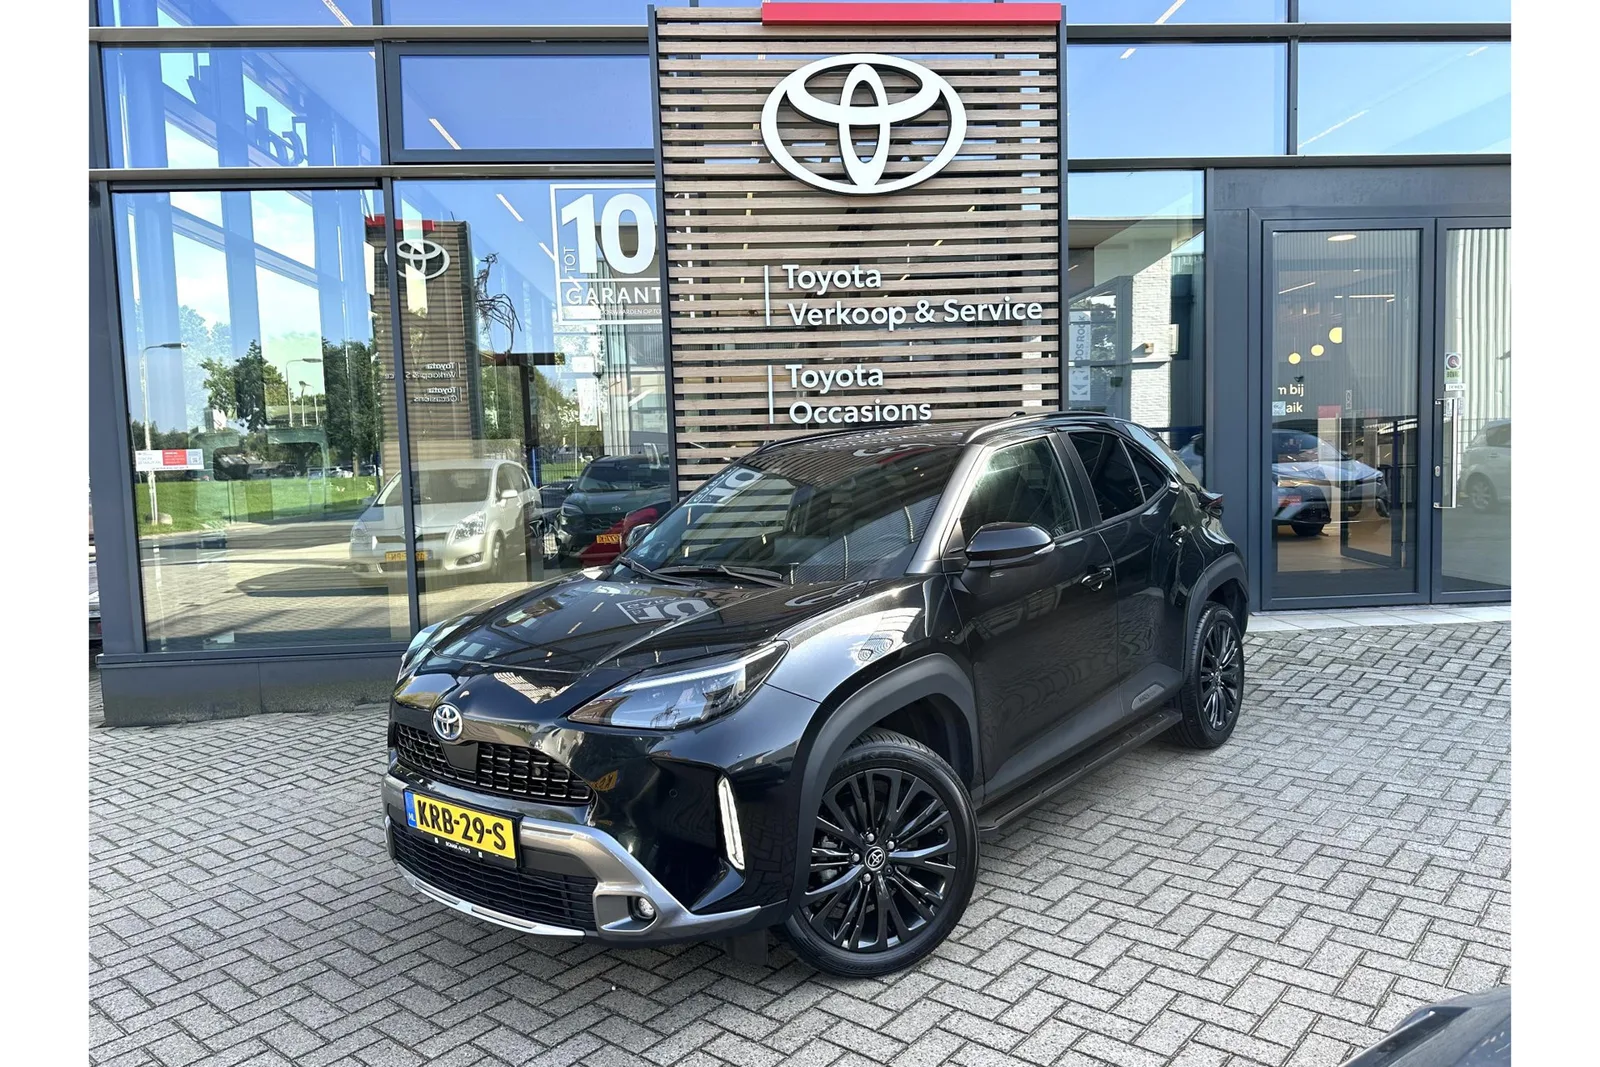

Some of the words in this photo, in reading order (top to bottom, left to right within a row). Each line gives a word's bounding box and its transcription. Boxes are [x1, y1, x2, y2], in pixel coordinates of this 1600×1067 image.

[561, 193, 656, 274] 10
[563, 247, 576, 273] TOT
[782, 264, 882, 296] Toyota
[787, 300, 907, 332] Verkoop
[915, 300, 936, 323] &
[943, 295, 1043, 323] Service
[785, 364, 884, 395] Toyota
[1290, 384, 1304, 397] bij
[789, 398, 932, 425] Occasions
[408, 812, 416, 822] NL
[417, 800, 506, 851] KRB-29-S
